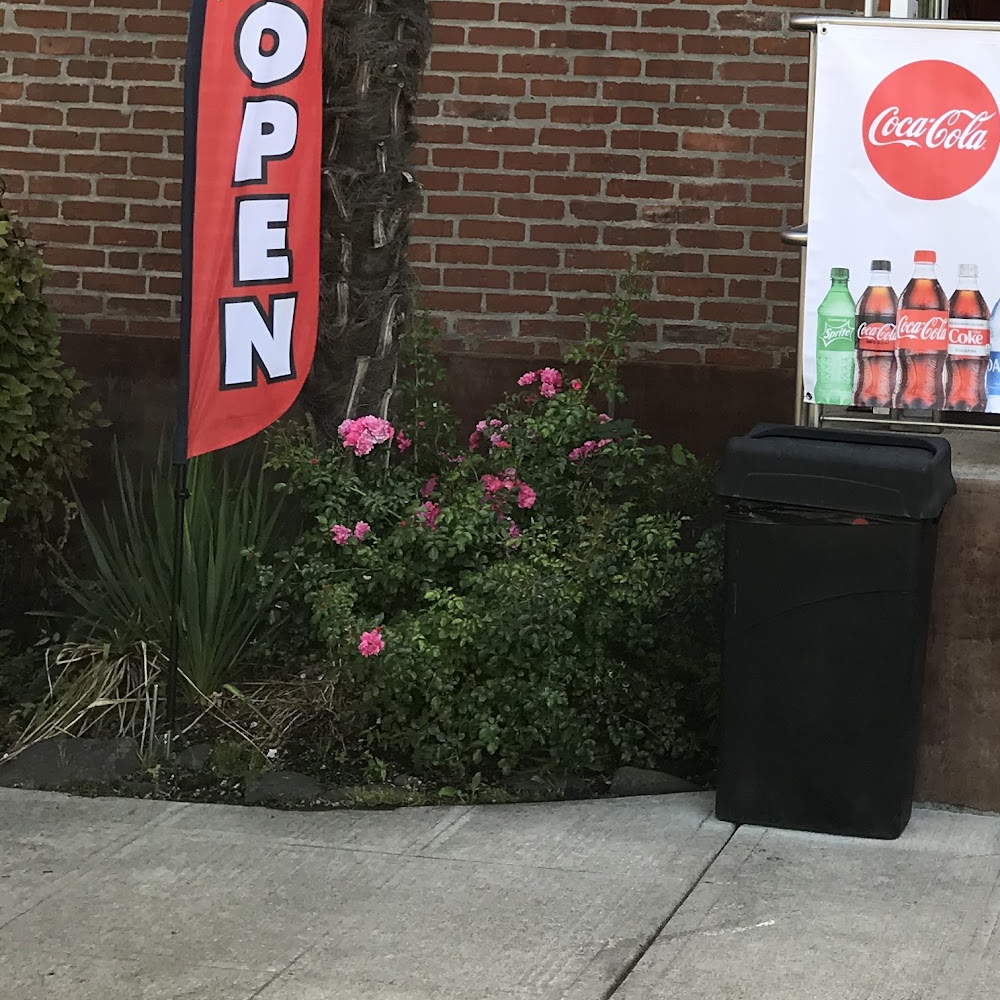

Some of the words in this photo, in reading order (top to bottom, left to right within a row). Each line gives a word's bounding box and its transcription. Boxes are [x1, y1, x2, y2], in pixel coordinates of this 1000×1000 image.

[868, 106, 996, 151] Coca-Cola
[823, 327, 851, 340] Sprite
[897, 315, 948, 340] Coca-Cola
[948, 328, 984, 344] Coke
